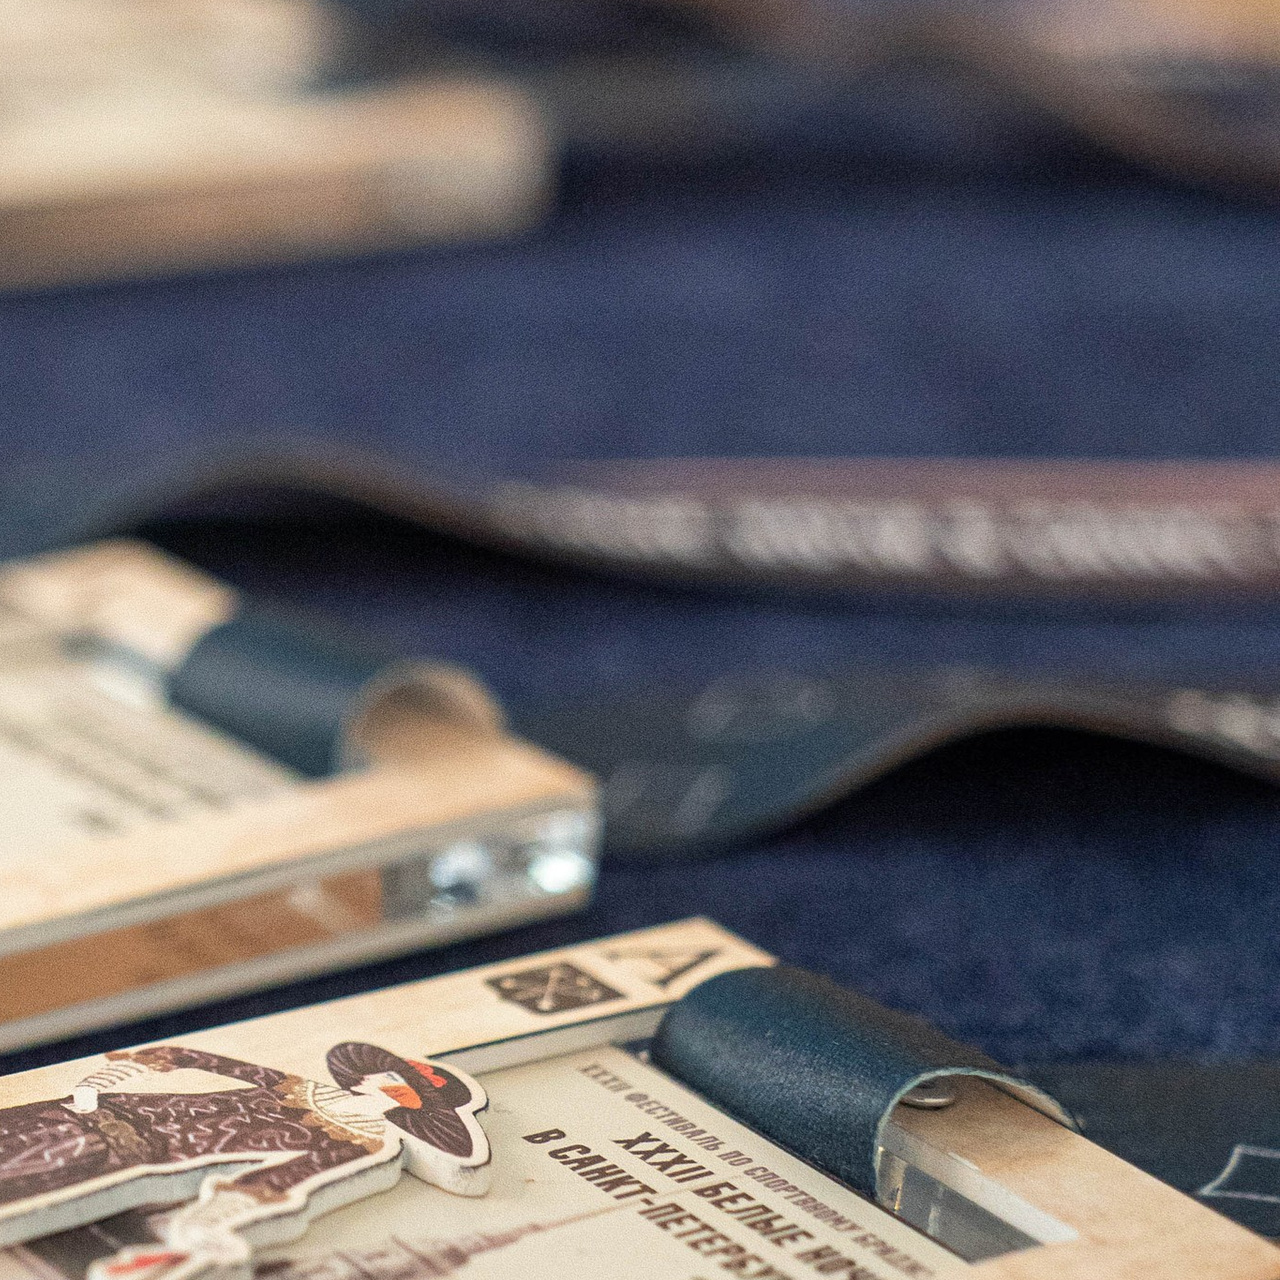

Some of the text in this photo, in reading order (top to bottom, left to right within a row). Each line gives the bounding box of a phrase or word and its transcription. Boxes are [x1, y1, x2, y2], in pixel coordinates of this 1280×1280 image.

[522, 1128, 567, 1145] В
[624, 1092, 725, 1152] ФЕСТИВАЛЬ
[717, 1150, 753, 1167] ПО
[691, 1181, 815, 1247] БЕЛЫЕ
